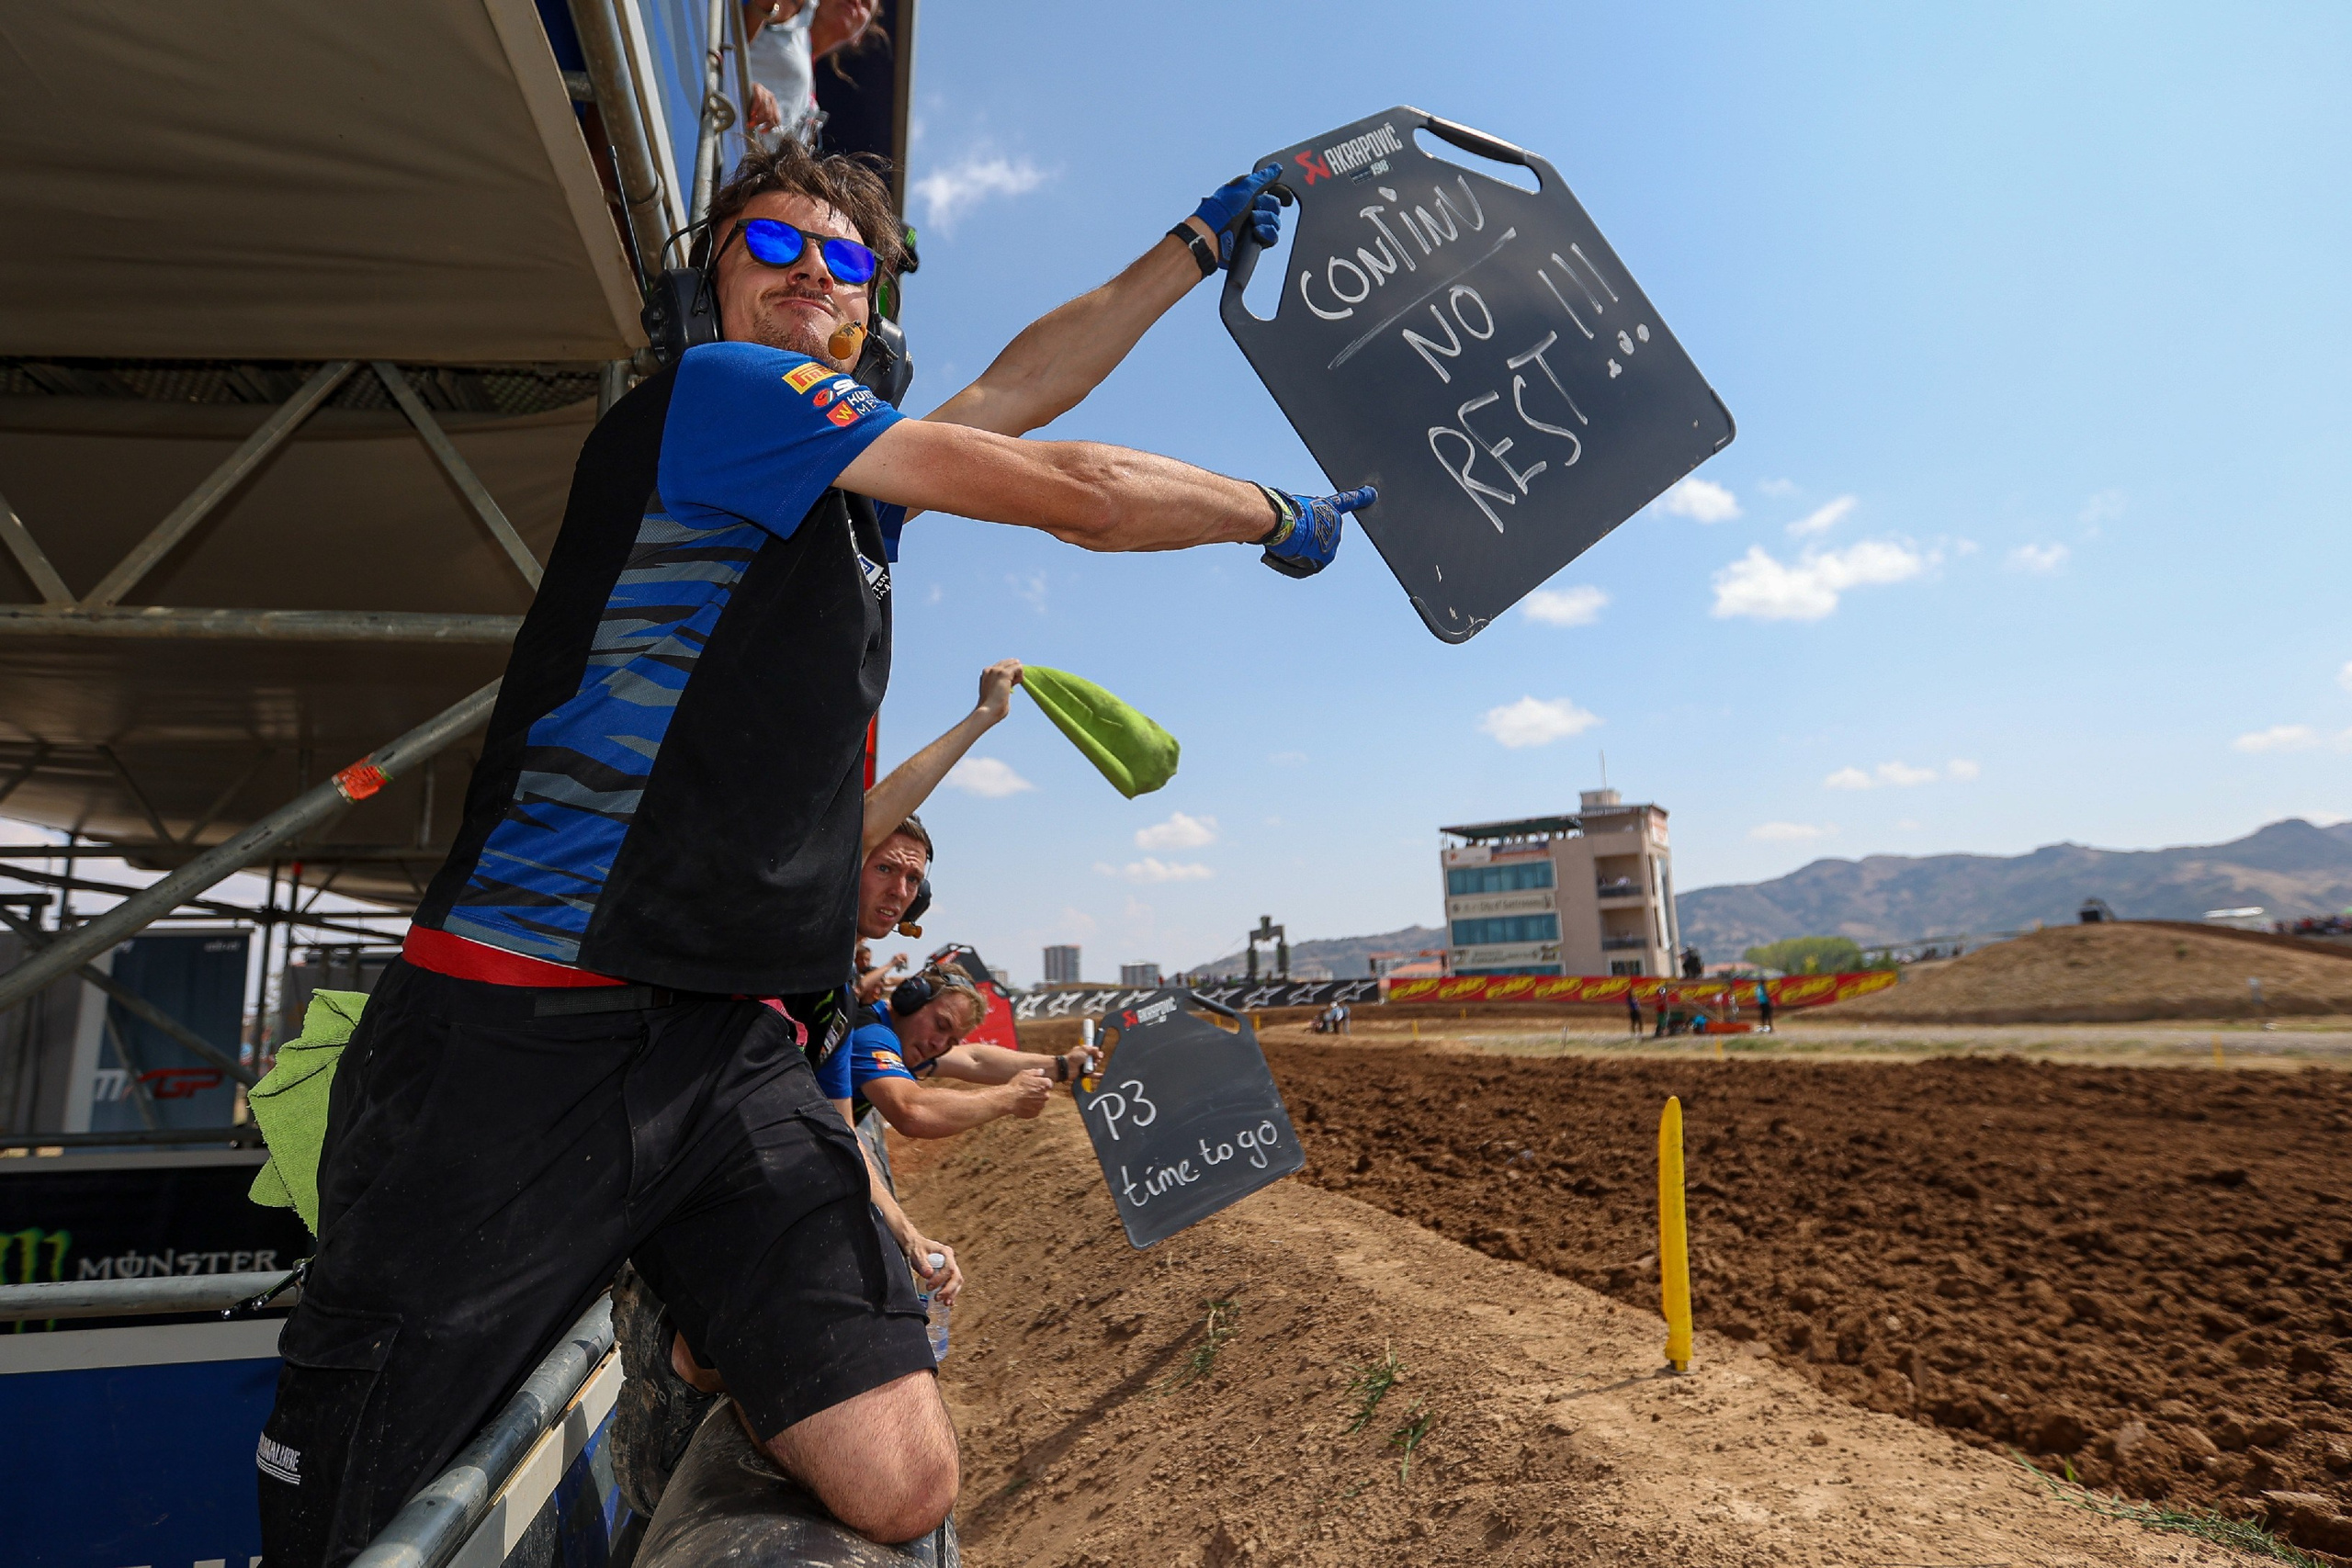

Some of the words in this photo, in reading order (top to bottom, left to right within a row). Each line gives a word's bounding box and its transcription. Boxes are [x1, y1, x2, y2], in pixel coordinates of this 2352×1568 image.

[1402, 284, 1495, 383] NO
[1428, 331, 1589, 534] REST
[1088, 1079, 1158, 1141] P3
[1121, 1158, 1201, 1207] time
[1198, 1139, 1234, 1165] to
[1237, 1120, 1278, 1169] go
[77, 1247, 278, 1281] MONSTER
